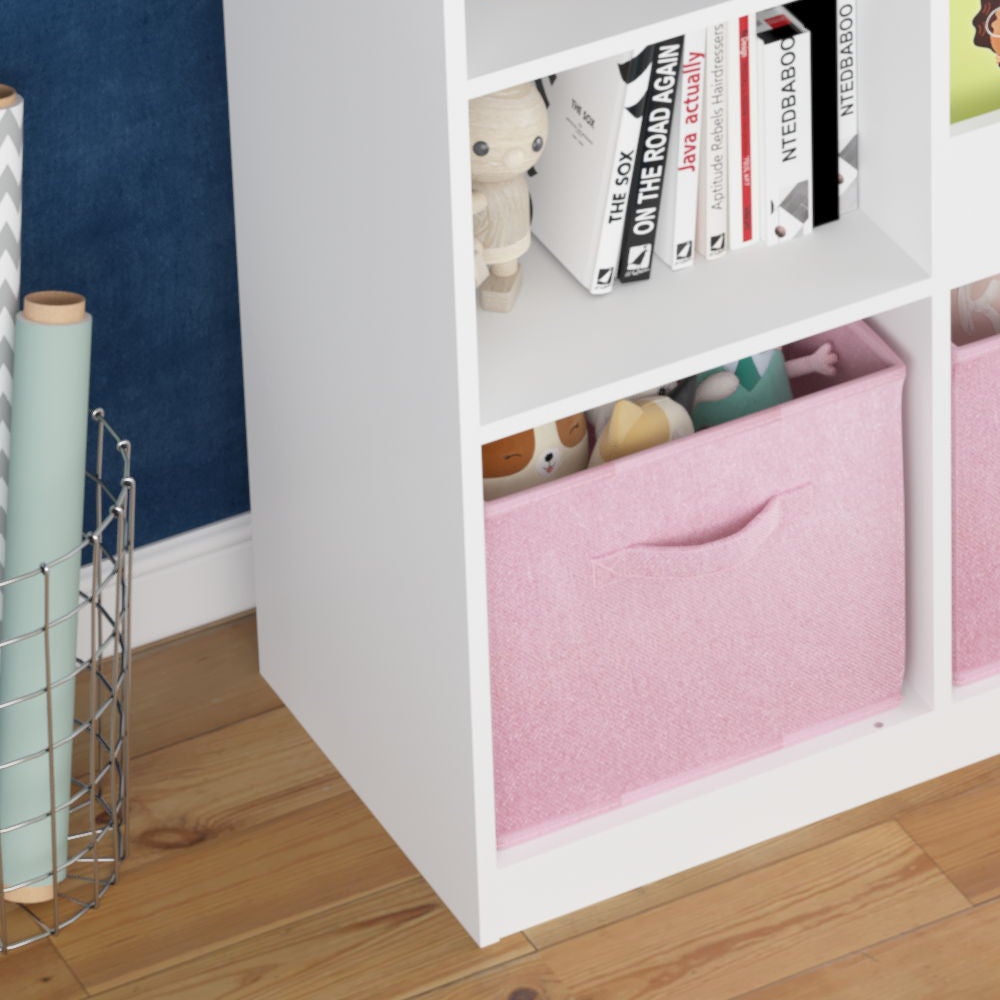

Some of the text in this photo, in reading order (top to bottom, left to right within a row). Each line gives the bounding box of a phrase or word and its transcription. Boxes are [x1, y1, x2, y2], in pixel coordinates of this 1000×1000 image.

[651, 43, 681, 104] AGAIN
[839, 3, 854, 118] NTEDBABOO
[643, 106, 672, 164] ROAD
[677, 51, 705, 172] Java actually
[711, 23, 726, 211] Aptitude Rebels Hairdressers
[780, 35, 797, 163] NTEDBABOO
[608, 149, 635, 224] THE SOX
[632, 206, 657, 236] ON
[637, 164, 663, 205] THE
